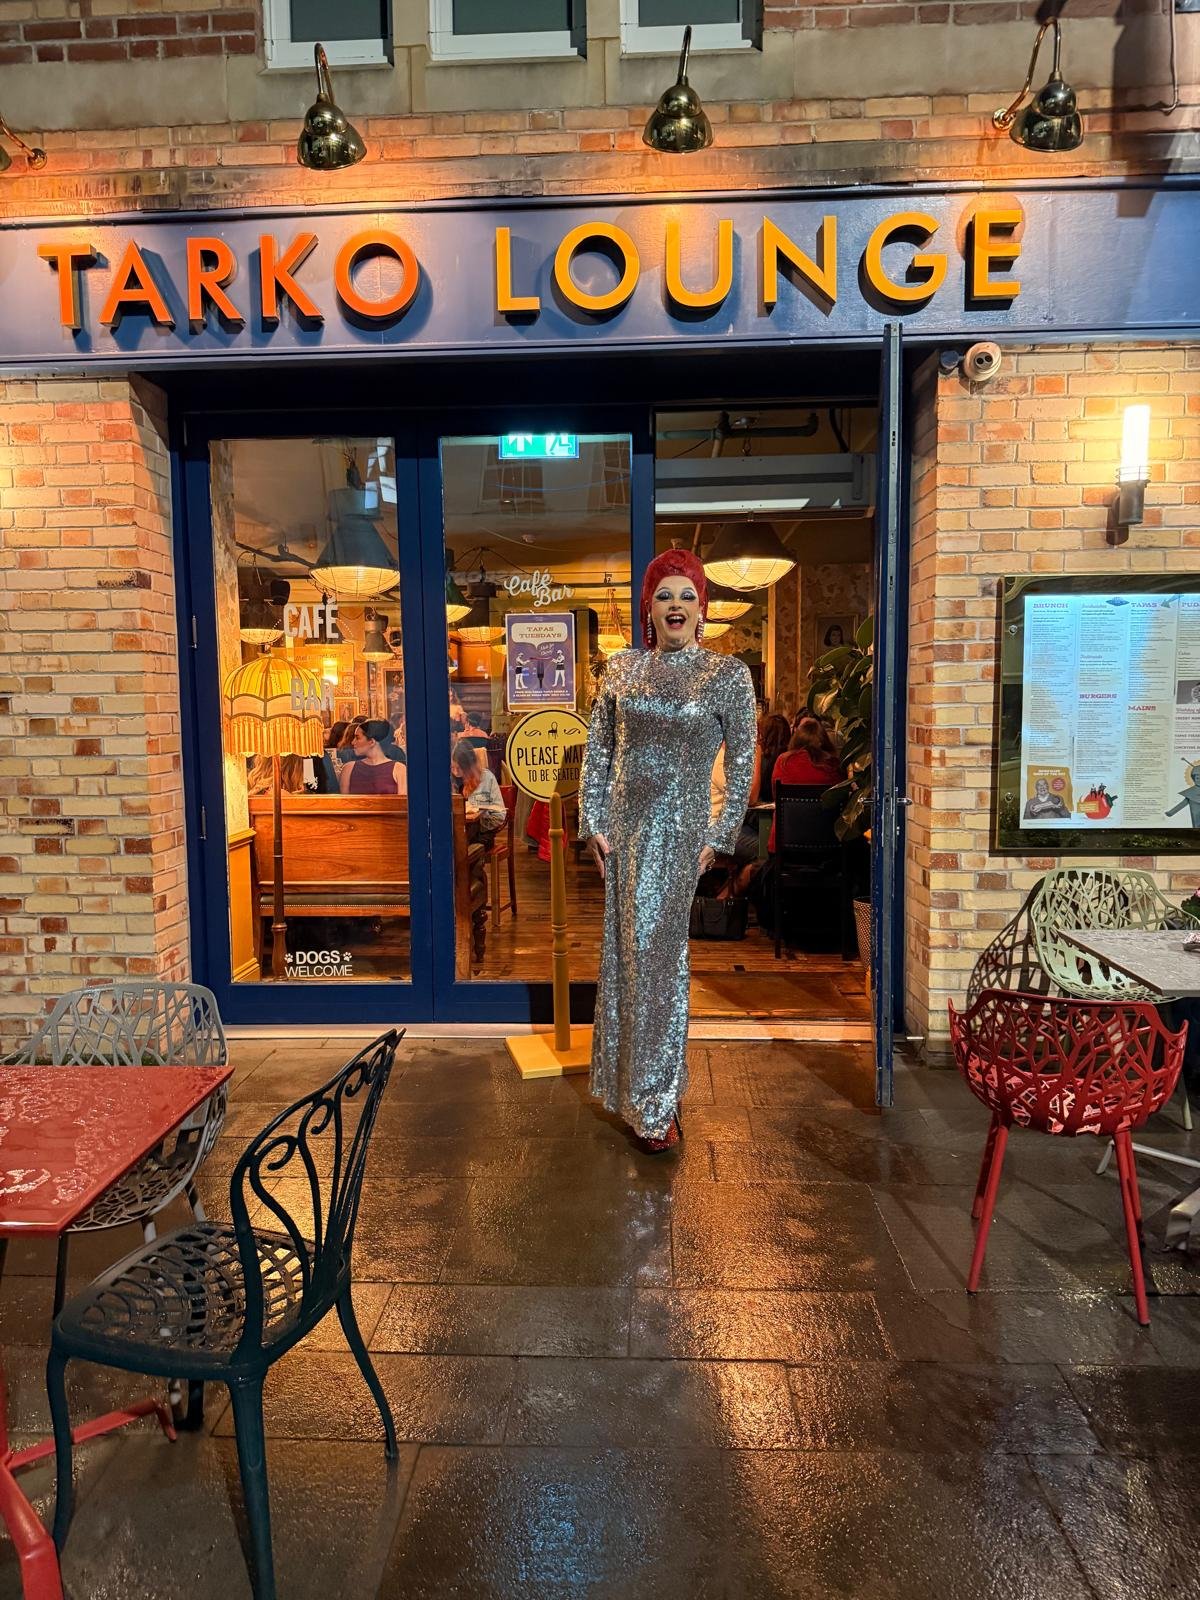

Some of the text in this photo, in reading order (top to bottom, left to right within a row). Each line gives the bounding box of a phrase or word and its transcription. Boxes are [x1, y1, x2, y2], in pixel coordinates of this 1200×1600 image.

[37, 209, 1023, 328] TARKO LOUNGE
[504, 568, 554, 597] Café
[534, 585, 575, 608] Bar
[283, 597, 339, 639] CAFÉ
[291, 678, 335, 711] BAR
[517, 745, 585, 766] PLEASE WAI
[528, 768, 580, 782] TO BE SEATED
[295, 950, 341, 965] DOGS
[284, 965, 353, 977] WELCOME
